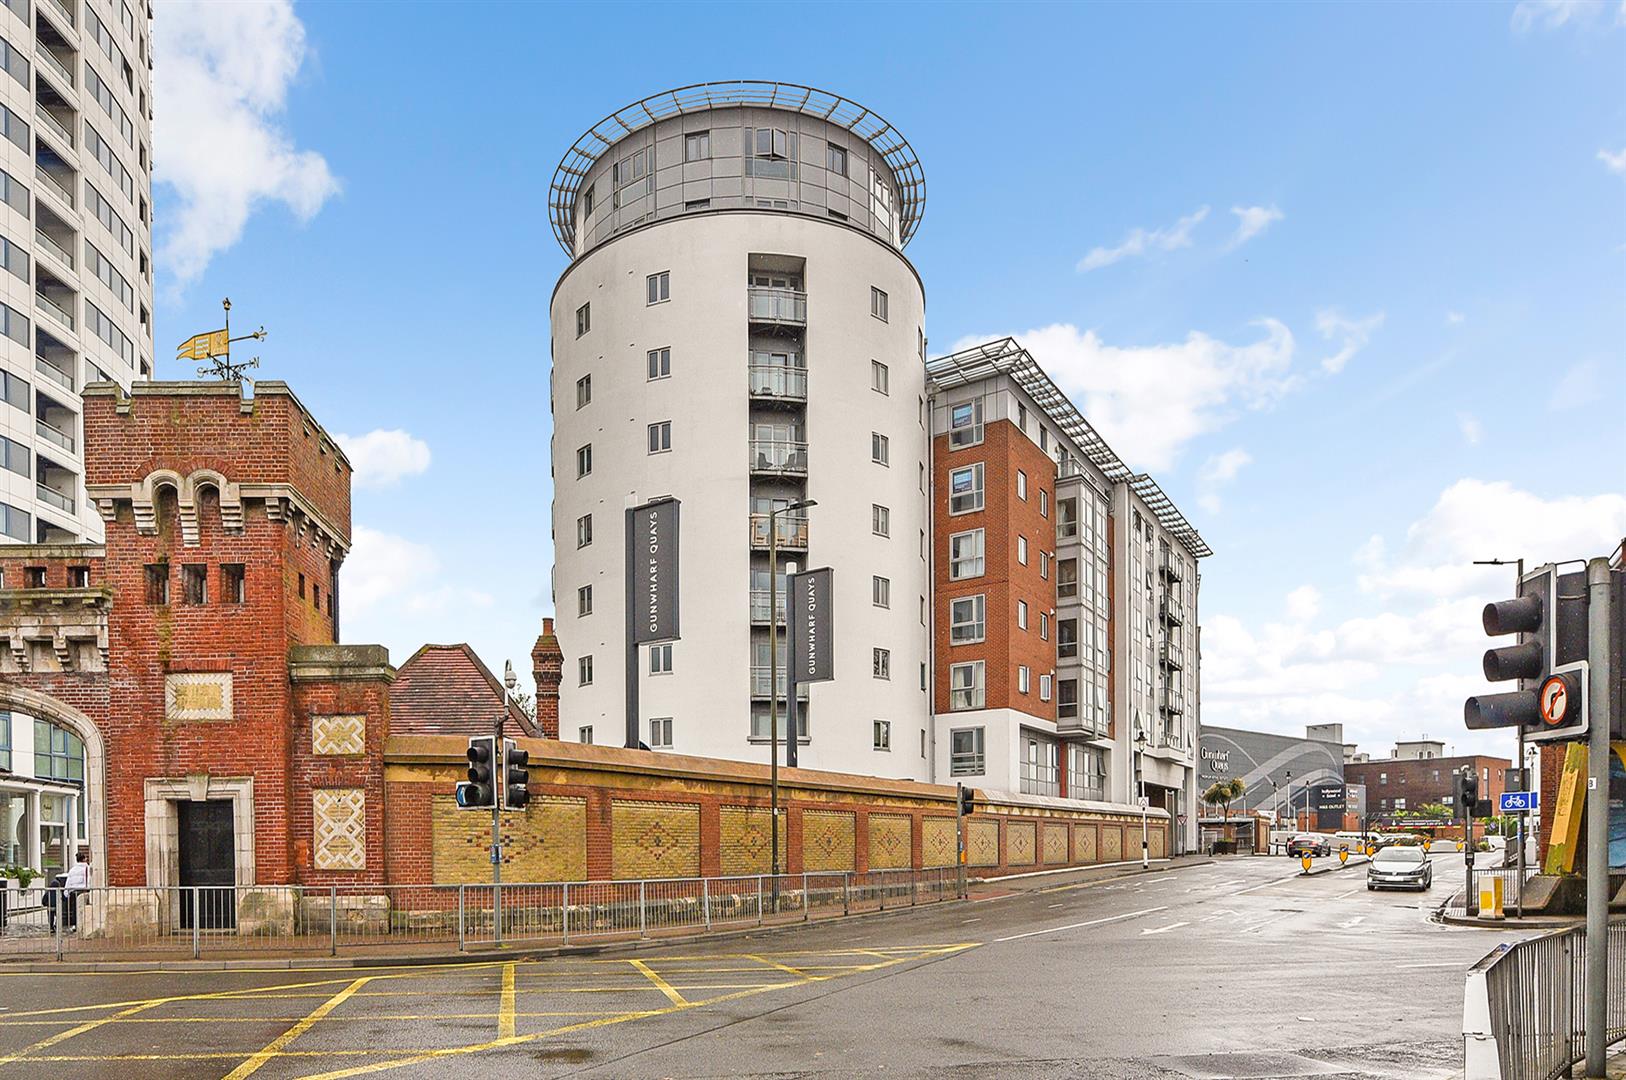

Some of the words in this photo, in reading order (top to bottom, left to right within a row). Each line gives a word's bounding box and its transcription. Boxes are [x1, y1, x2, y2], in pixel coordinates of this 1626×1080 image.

[649, 511, 658, 553] QUAYS
[649, 558, 658, 633] GUNWHARF
[808, 577, 816, 611] QUAYS
[808, 614, 816, 675] GUNWHARF
